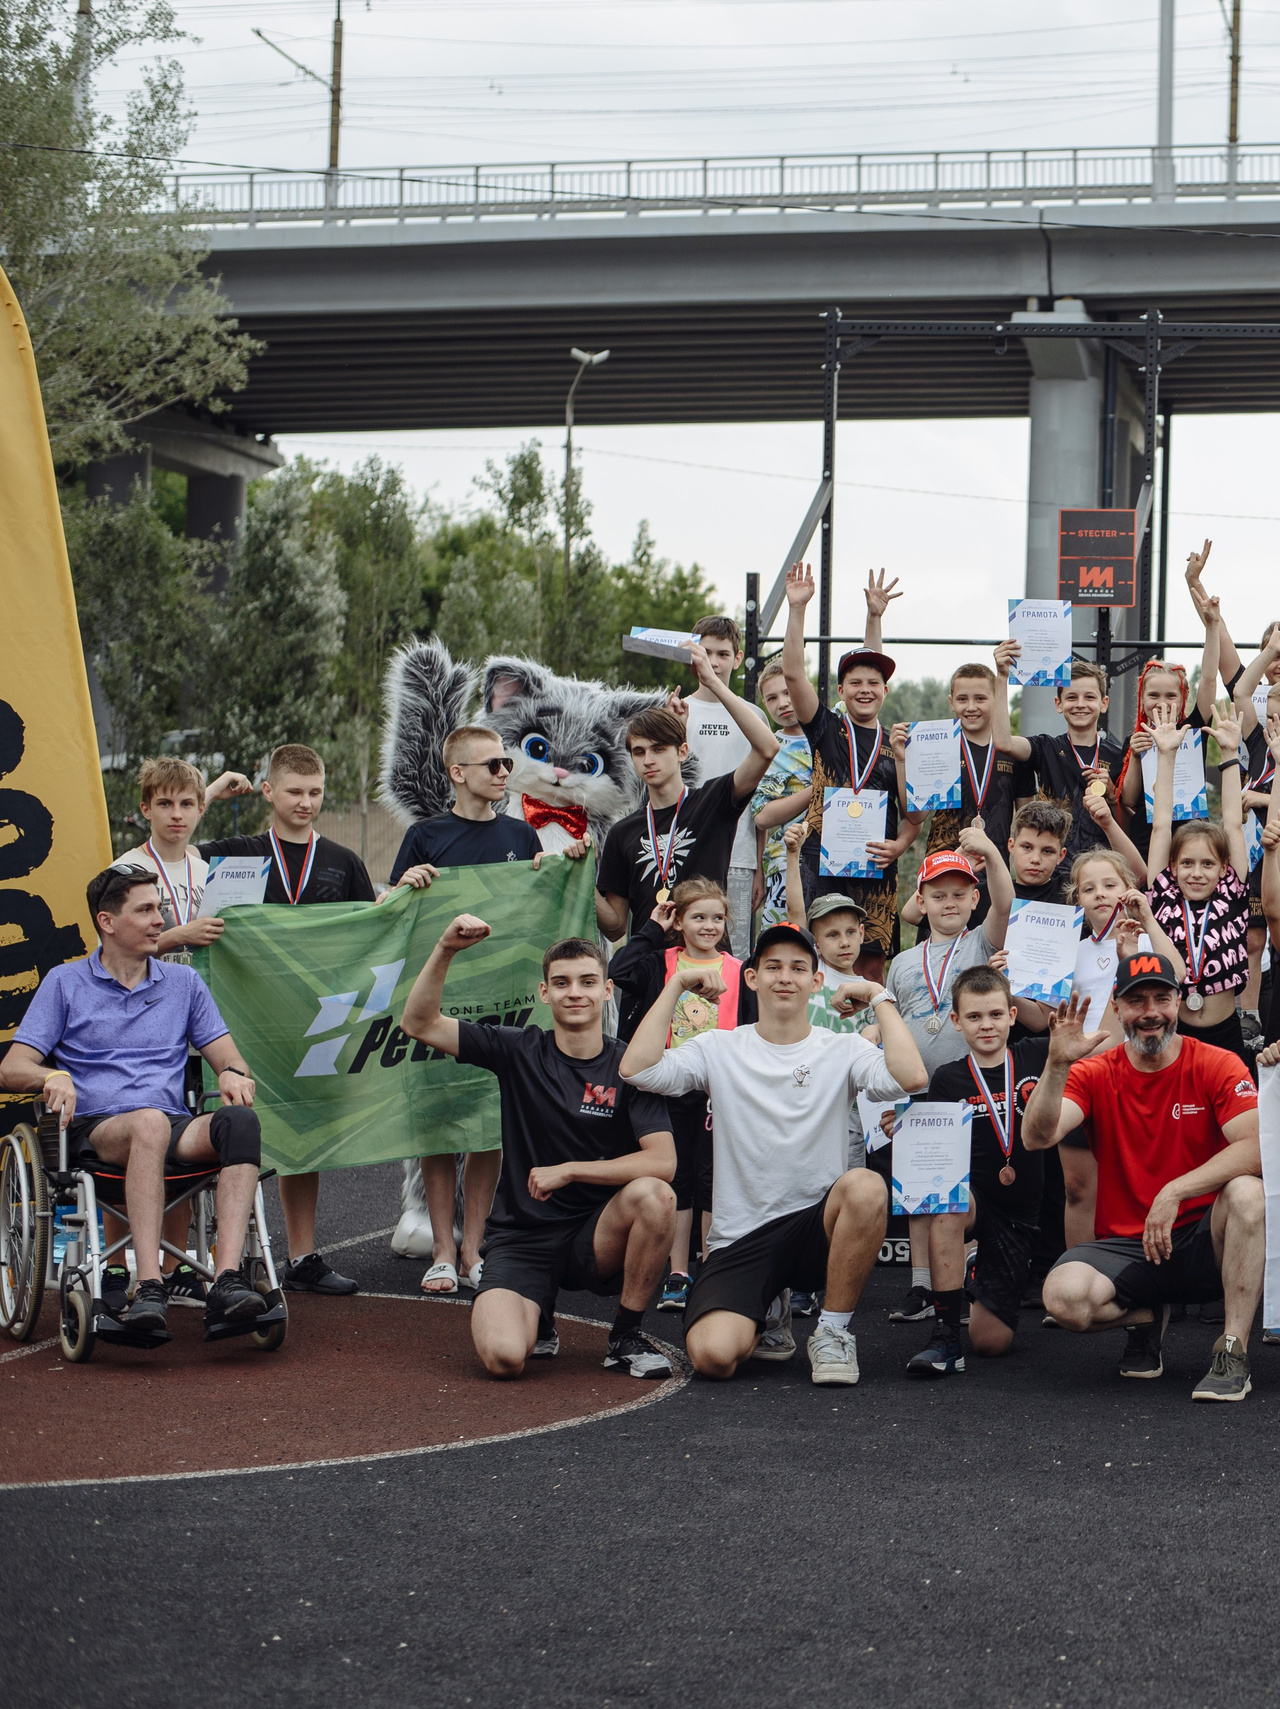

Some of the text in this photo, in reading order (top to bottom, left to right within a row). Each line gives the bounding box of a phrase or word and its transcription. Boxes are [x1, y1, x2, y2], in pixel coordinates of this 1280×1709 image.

[1078, 530, 1117, 538] STECTER
[917, 732, 948, 741] ГРАМОТА
[837, 800, 873, 809] ГРАОТА
[221, 871, 256, 879] ГРАМОТА
[1025, 915, 1066, 928] ГРАМОТА
[450, 994, 536, 1015] ONE TEAM
[968, 1092, 1006, 1104] CRSS
[910, 1118, 954, 1127] ГРАМОТА
